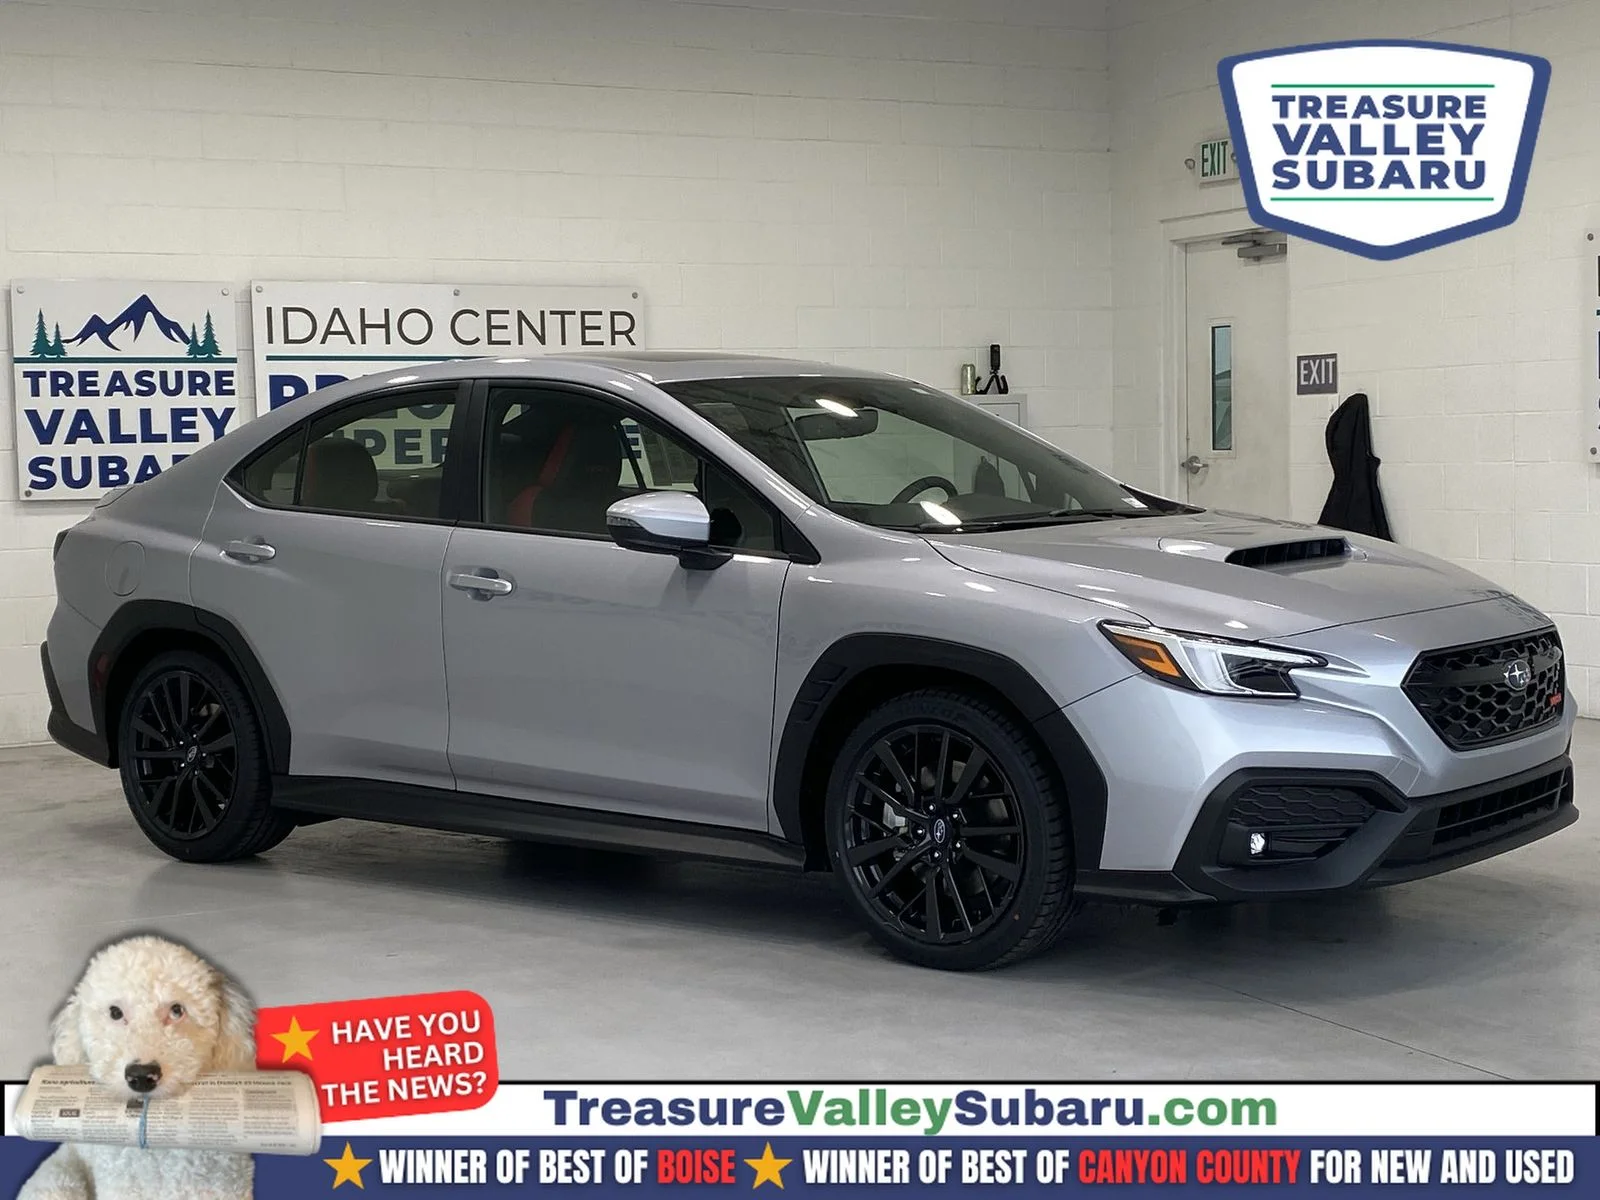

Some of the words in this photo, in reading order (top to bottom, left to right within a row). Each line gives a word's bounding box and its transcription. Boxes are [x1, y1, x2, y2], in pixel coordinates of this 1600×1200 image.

[1201, 140, 1229, 177] EXIT
[266, 306, 434, 346] IDAHO
[450, 308, 637, 347] CENTER
[22, 369, 236, 398] TREASURE
[1300, 358, 1336, 385] EXIT
[24, 407, 236, 445] VALLEY
[28, 454, 193, 491] SUBA
